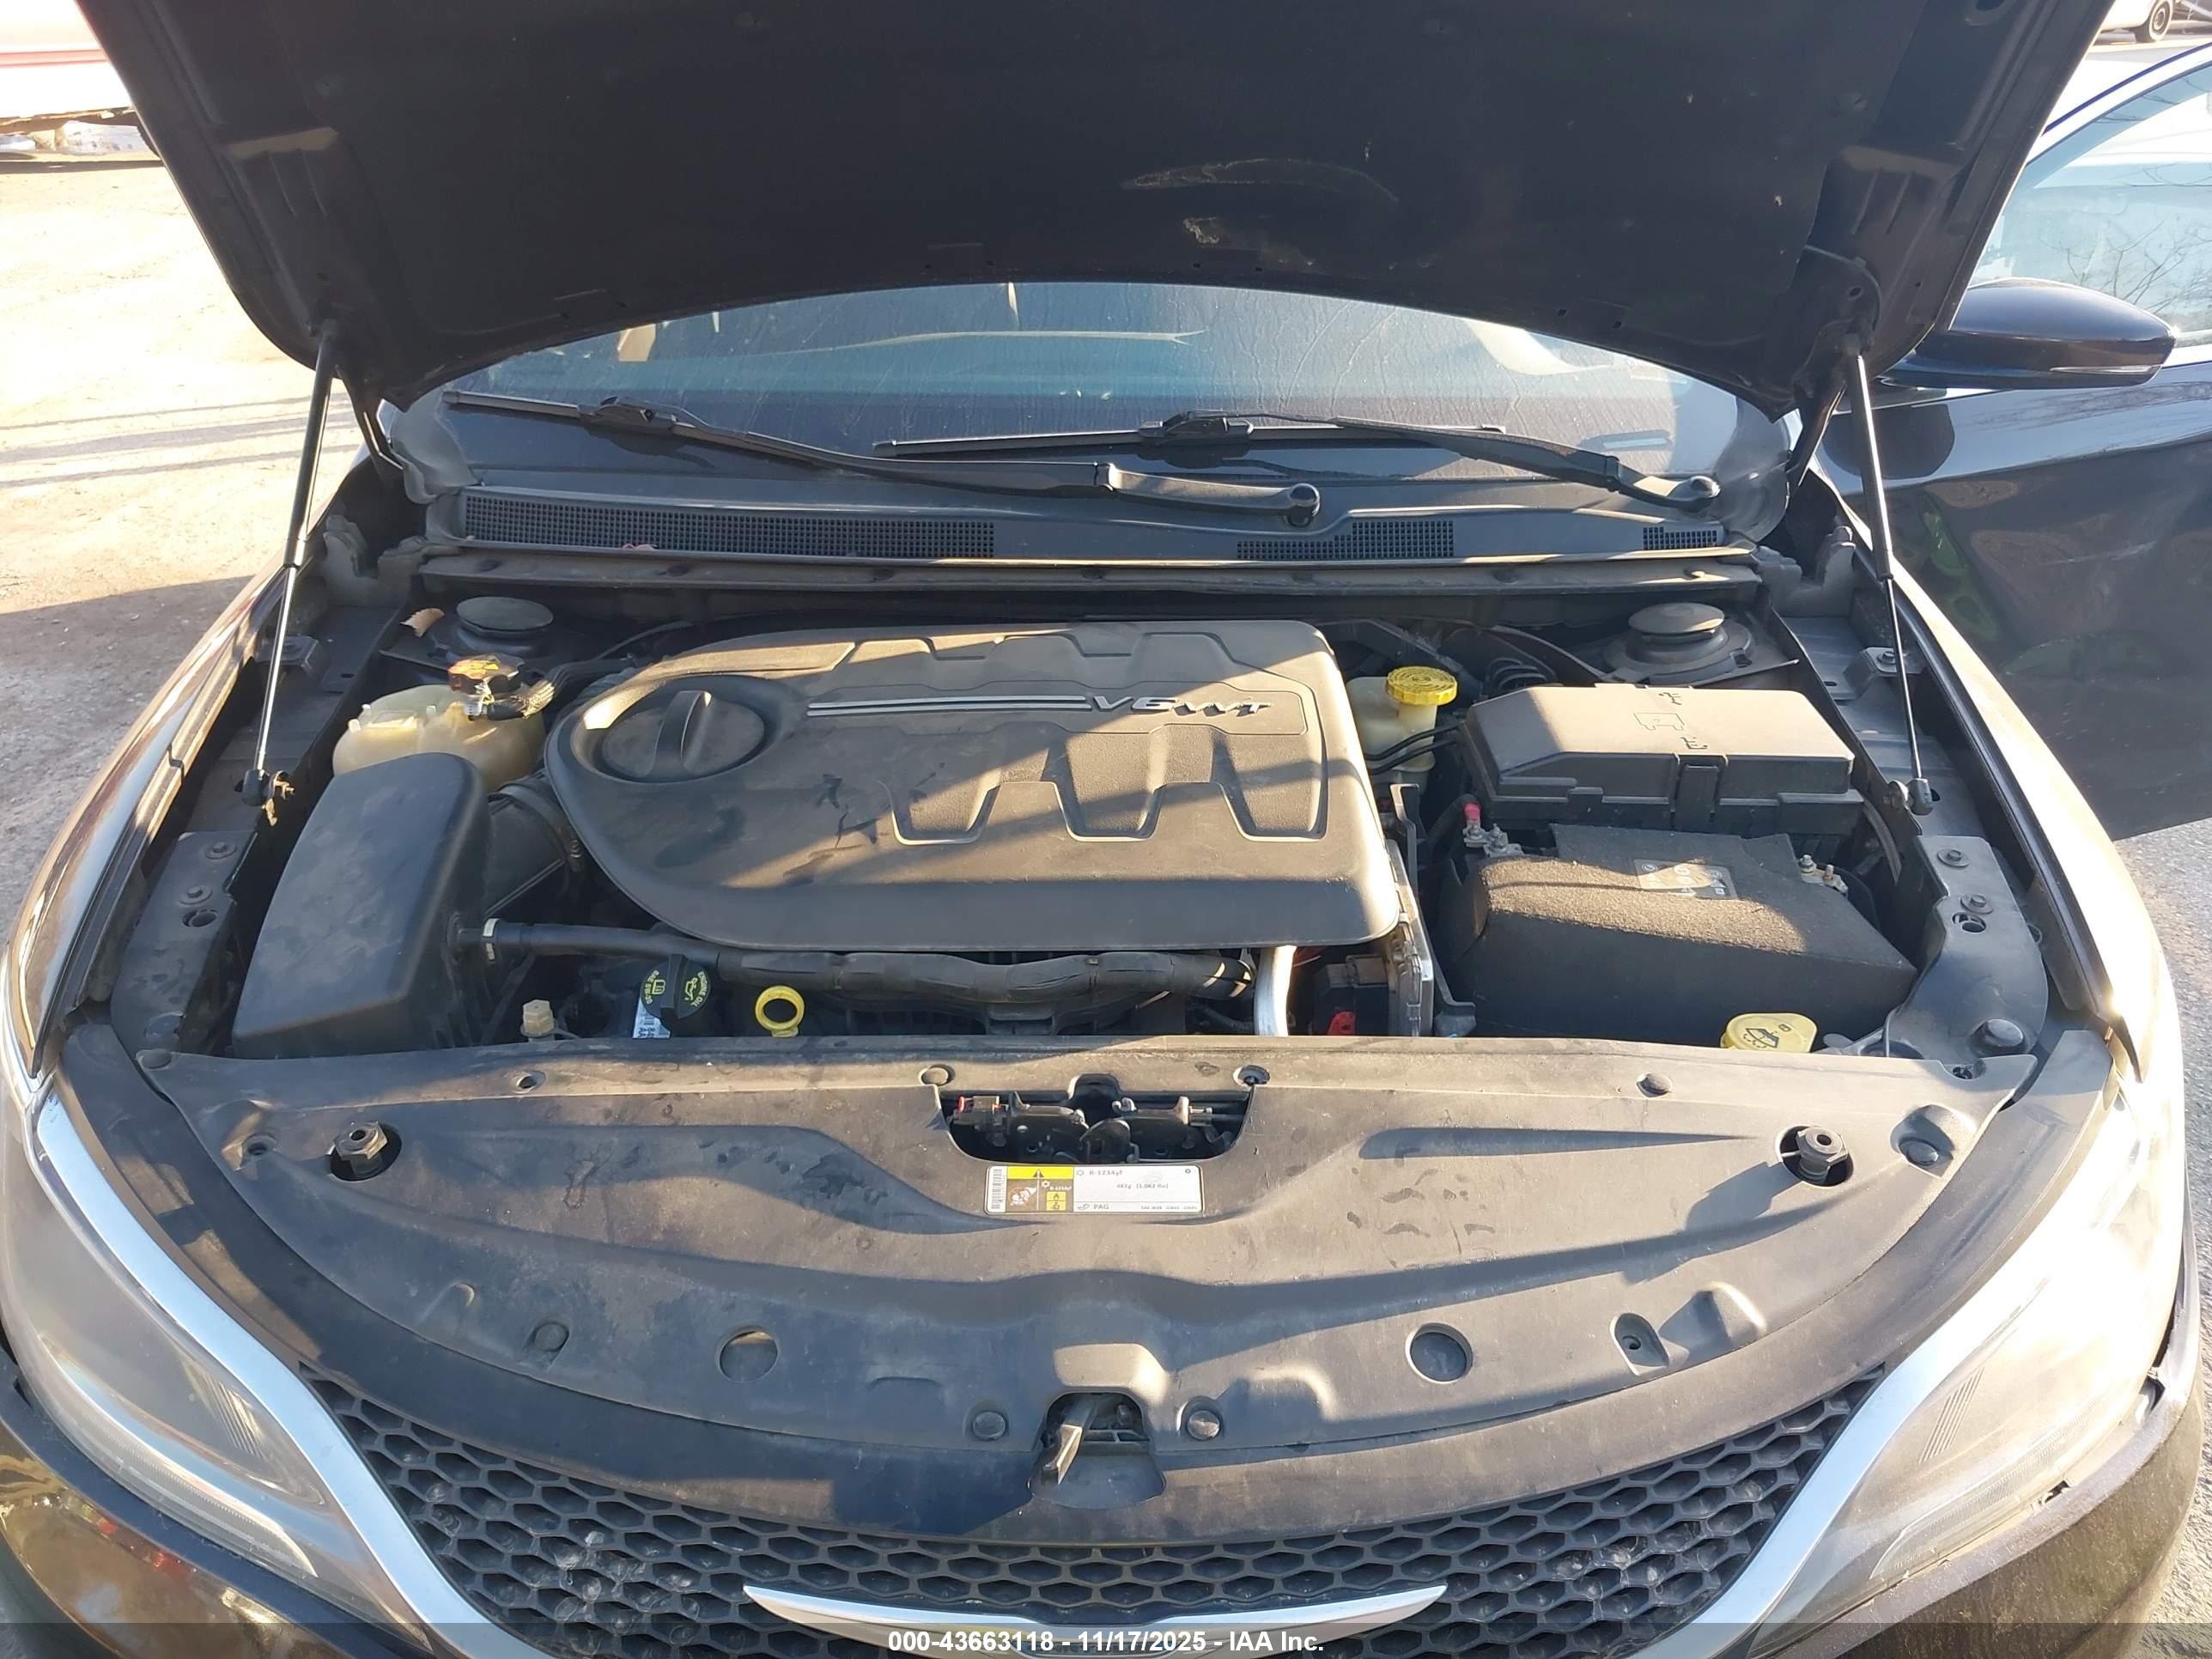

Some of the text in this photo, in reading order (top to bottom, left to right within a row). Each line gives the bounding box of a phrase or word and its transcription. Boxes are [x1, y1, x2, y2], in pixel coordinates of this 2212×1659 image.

[1093, 696, 1178, 712] V6
[690, 971, 708, 1006] ENGINE OIL
